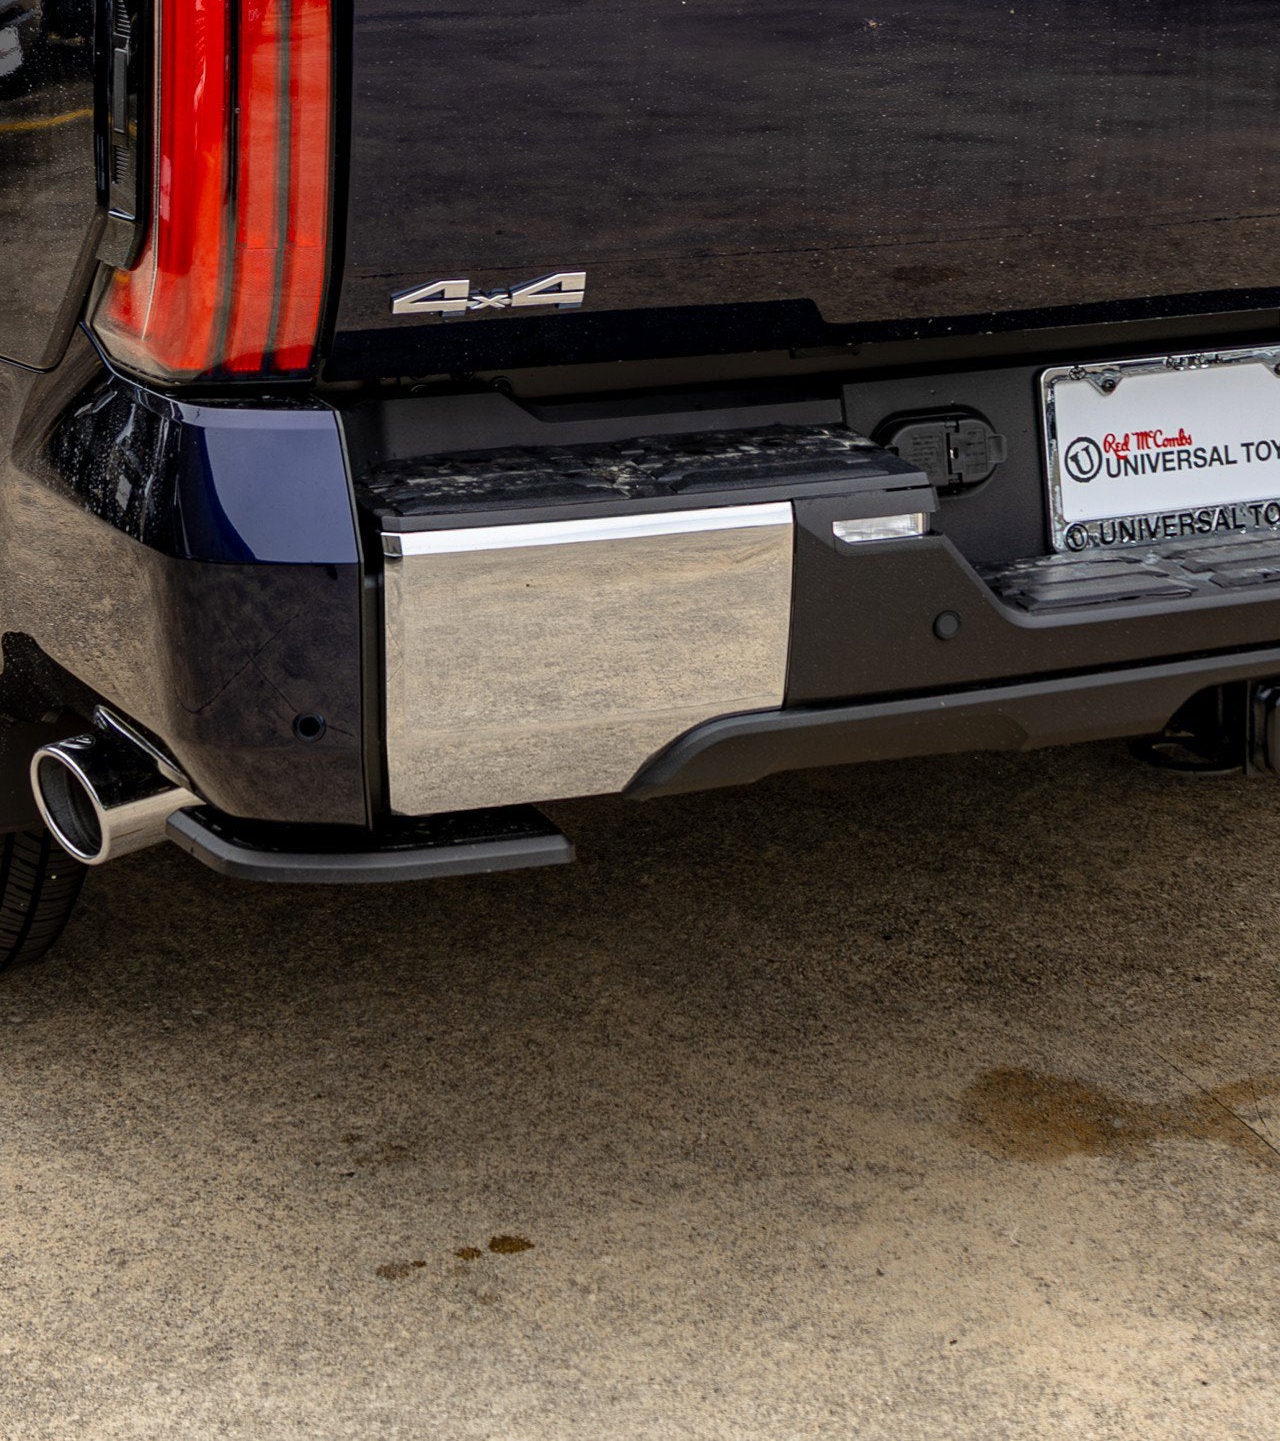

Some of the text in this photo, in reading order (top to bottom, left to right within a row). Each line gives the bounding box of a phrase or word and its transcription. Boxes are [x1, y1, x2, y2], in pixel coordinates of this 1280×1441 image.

[391, 271, 587, 318] 4x4
[1103, 432, 1131, 459] Red
[1105, 445, 1238, 479] UNIVERSAL
[1099, 507, 1246, 546] UNIVERSAL
